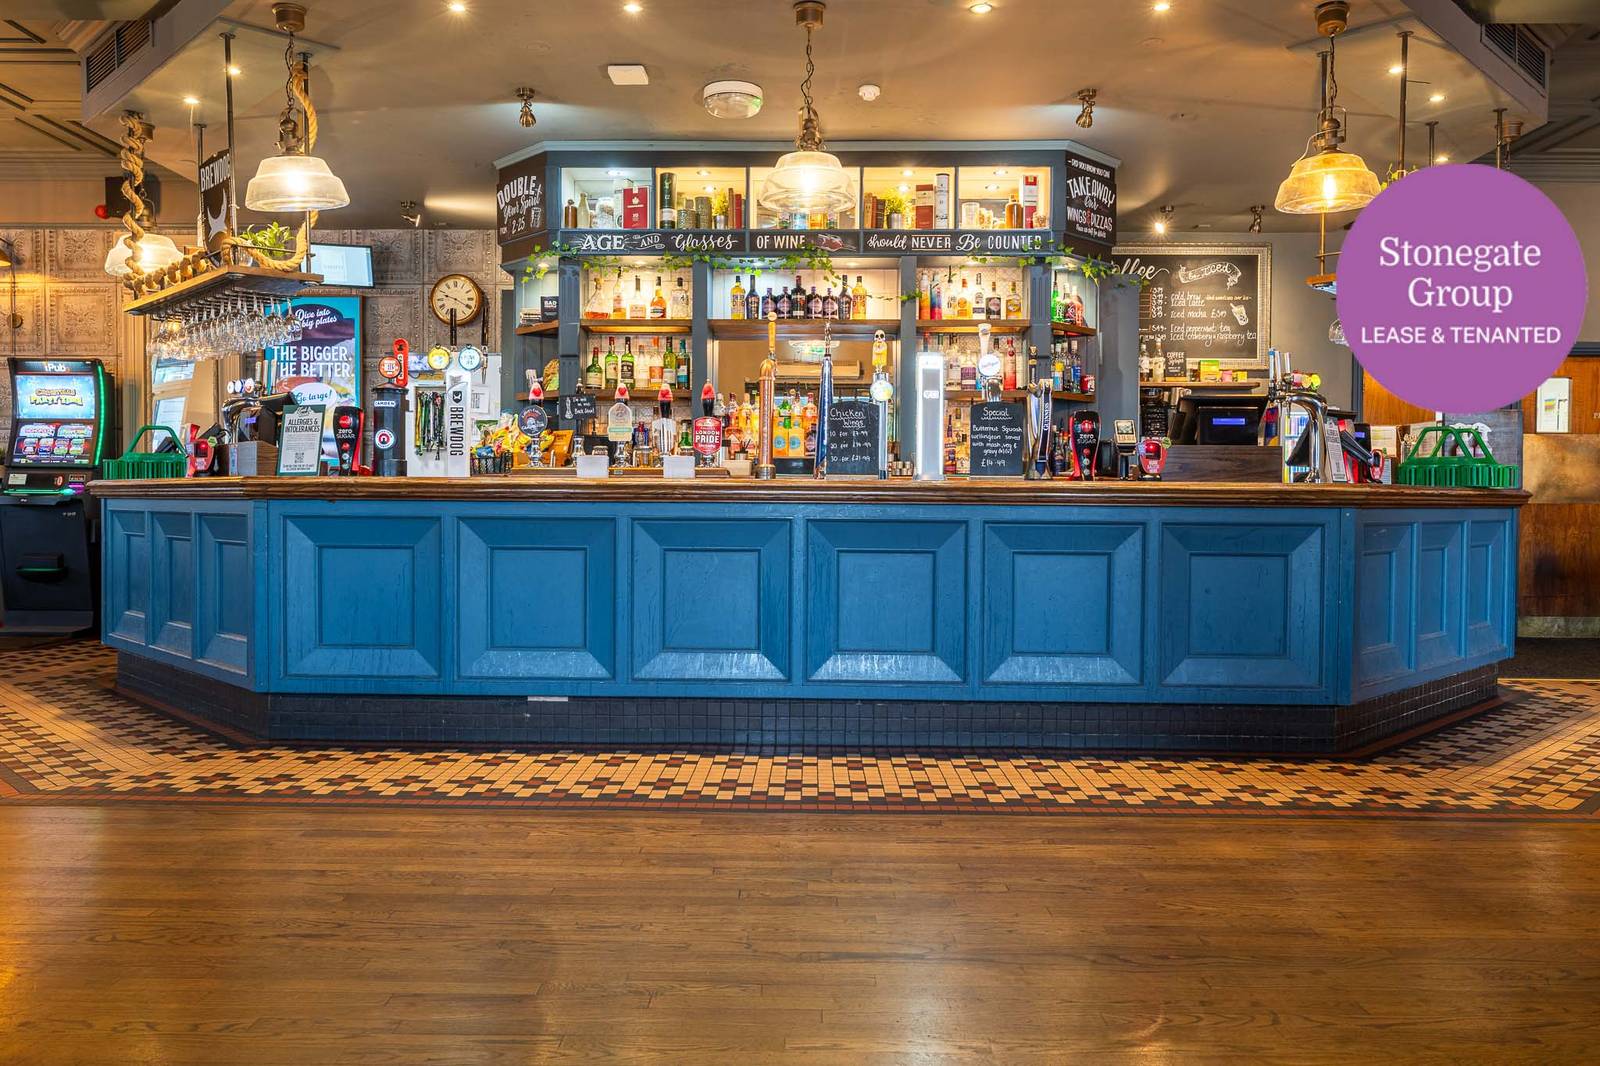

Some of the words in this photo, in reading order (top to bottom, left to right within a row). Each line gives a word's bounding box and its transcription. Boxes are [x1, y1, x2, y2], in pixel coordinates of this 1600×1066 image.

[497, 176, 537, 210] DOUBLE
[1066, 175, 1115, 208] TAKEAWAY
[1066, 206, 1087, 224] WINGS
[1091, 213, 1113, 232] PIZZAS
[581, 234, 626, 250] AGE
[640, 235, 661, 247] AND
[671, 233, 738, 250] Glasses
[757, 235, 771, 249] OF
[773, 235, 805, 249] WINE
[866, 234, 907, 250] should
[912, 236, 952, 249] NEVER
[956, 233, 982, 252] Be
[987, 235, 1042, 249] COUNTED
[295, 309, 315, 321] Dive
[316, 308, 331, 317] into
[302, 319, 314, 330] big
[315, 315, 338, 328] plates
[273, 346, 297, 361] THE
[301, 346, 352, 361] BIGGER.
[277, 362, 297, 377] HE
[301, 362, 354, 377] BETTER.
[295, 391, 307, 402] Go
[309, 389, 333, 401] large!
[830, 408, 864, 418] Chicken
[983, 407, 1009, 418] Special
[288, 418, 314, 426] ALLERGIES
[843, 420, 864, 429] Wings
[285, 425, 321, 433] INTOLERANCES
[450, 407, 464, 456] BREWDOG
[1001, 425, 1022, 433] Squash
[695, 435, 720, 443] PRIDE
